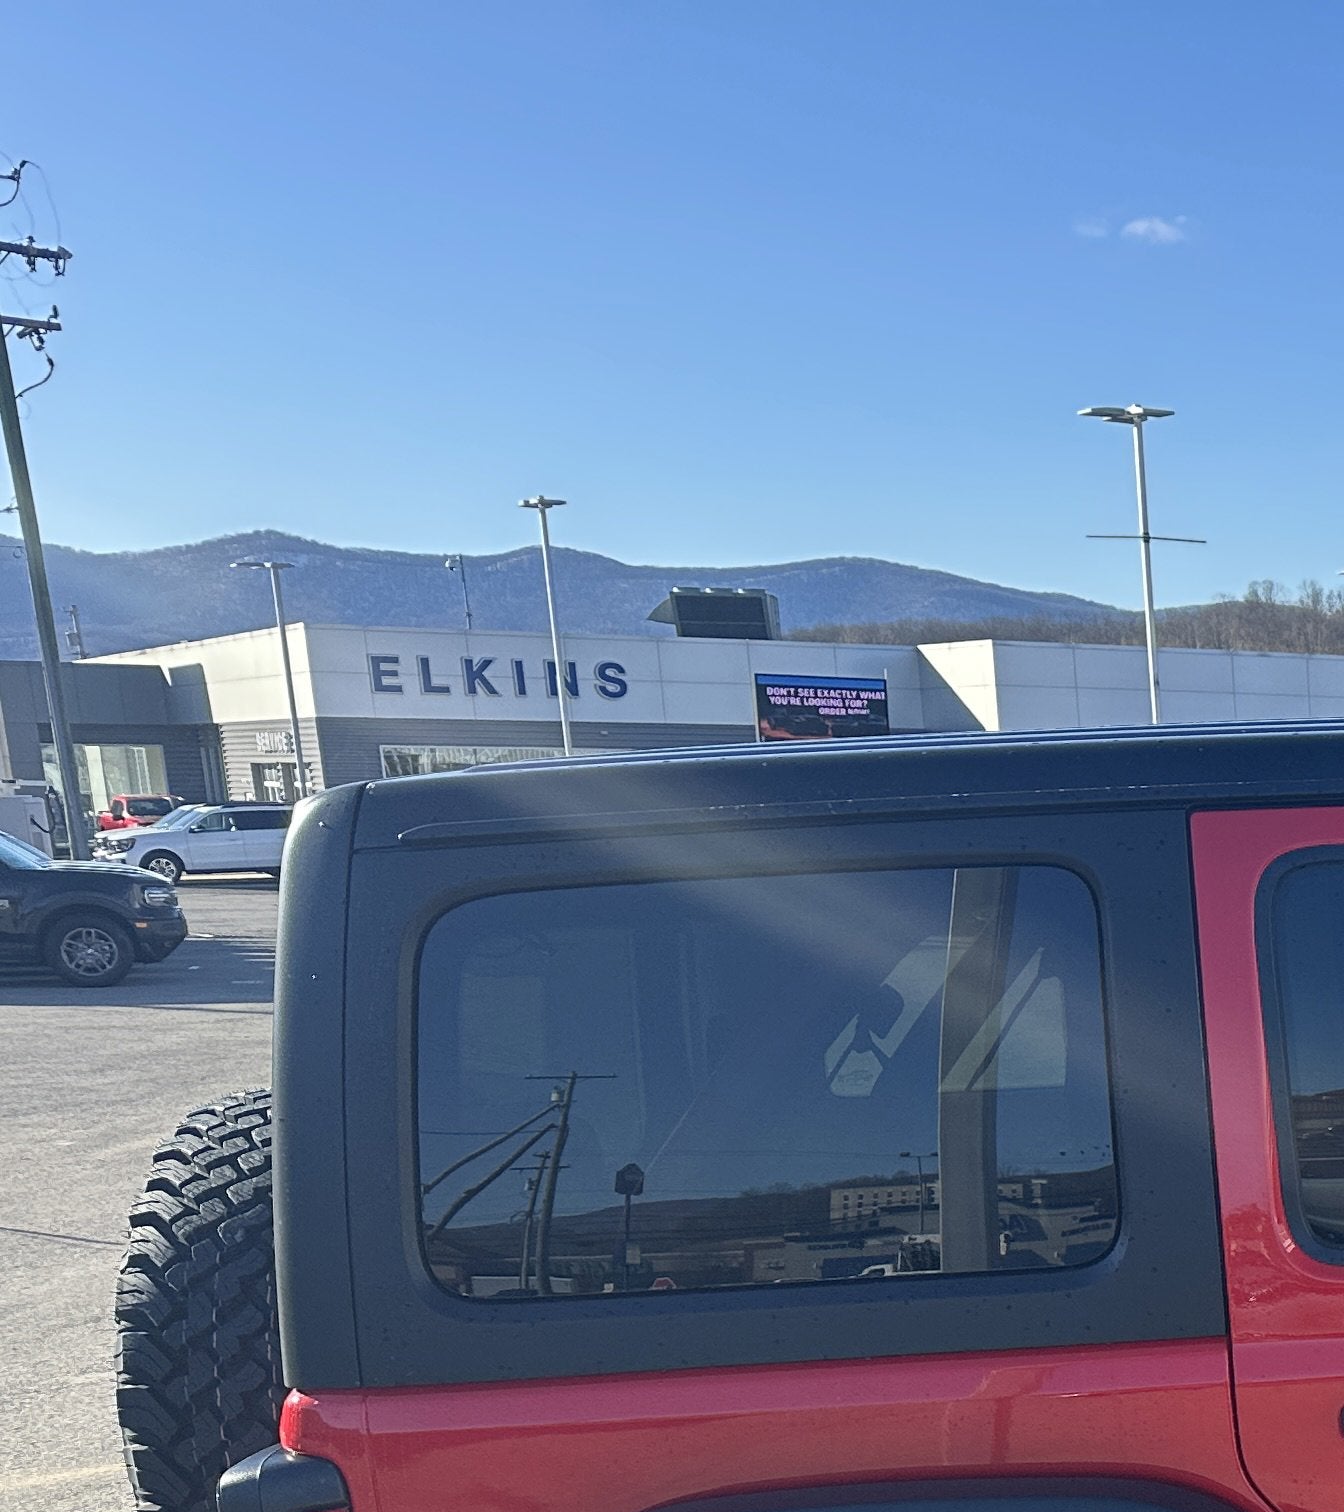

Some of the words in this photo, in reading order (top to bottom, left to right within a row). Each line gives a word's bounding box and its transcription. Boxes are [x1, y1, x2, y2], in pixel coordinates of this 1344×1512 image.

[369, 654, 628, 699] ELKINS
[798, 687, 815, 697] SEE
[817, 688, 857, 699] EXACTLY
[860, 690, 885, 700] WHAT
